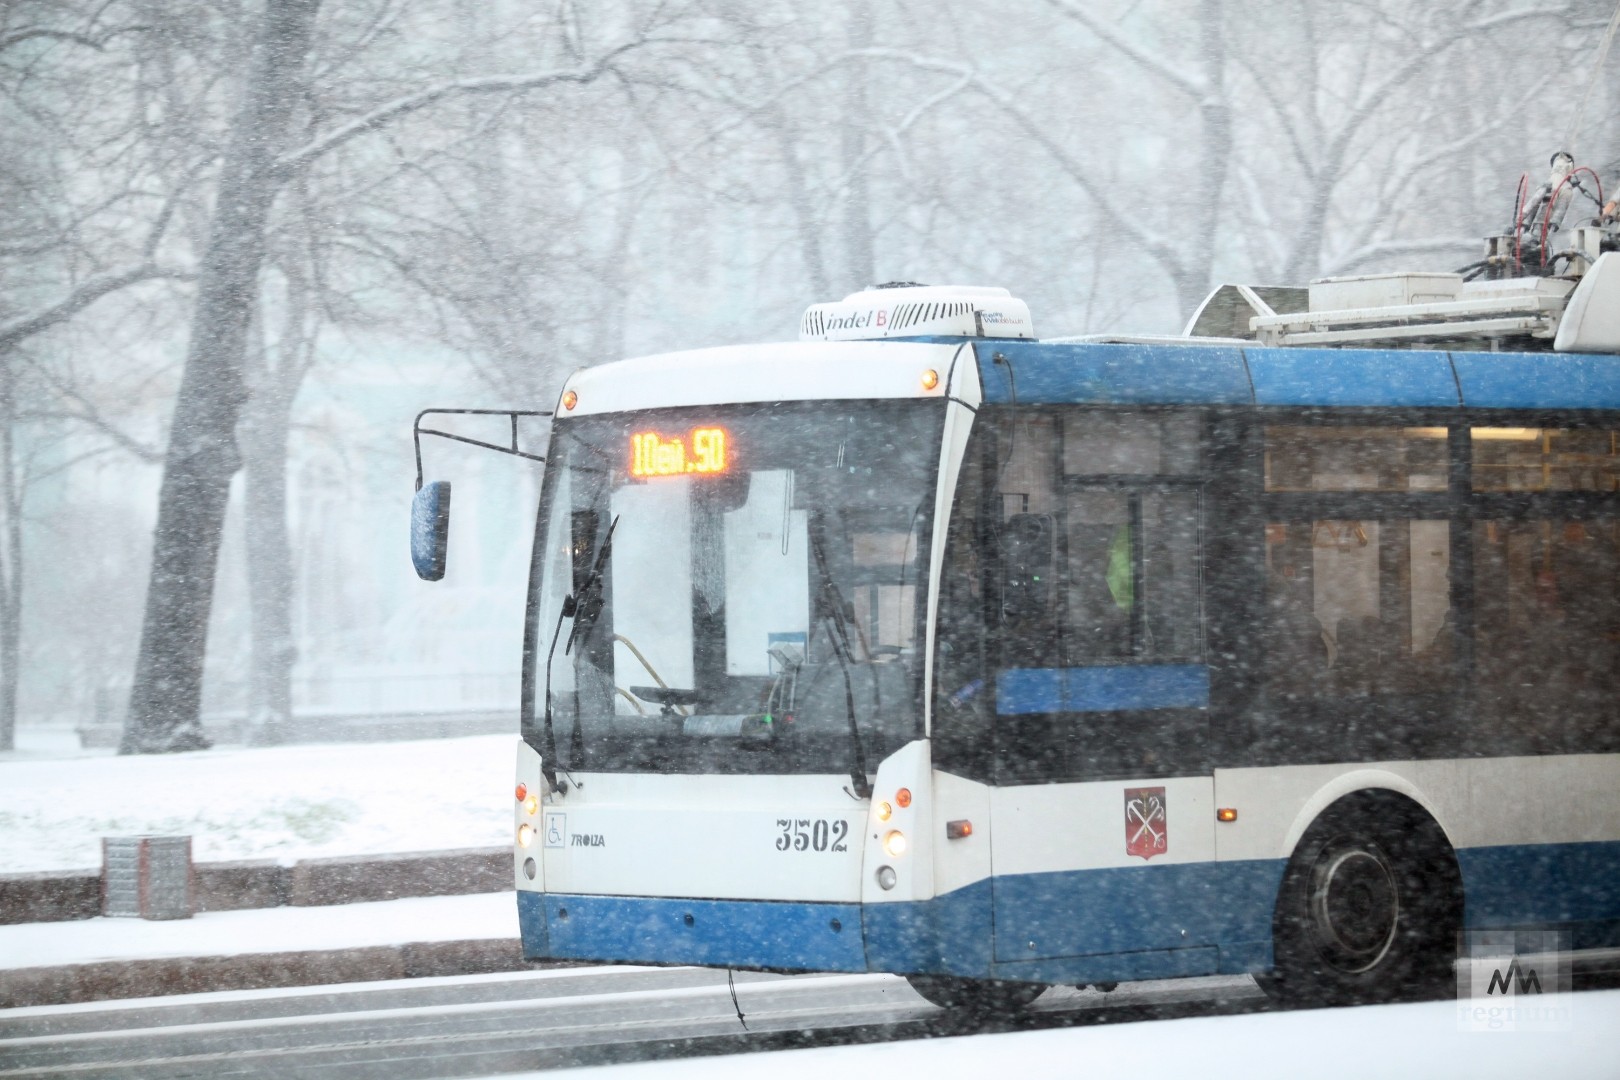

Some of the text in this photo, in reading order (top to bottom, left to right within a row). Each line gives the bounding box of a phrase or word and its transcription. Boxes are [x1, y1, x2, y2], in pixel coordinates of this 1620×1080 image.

[826, 310, 888, 330] indel B
[775, 819, 849, 852] 3502
